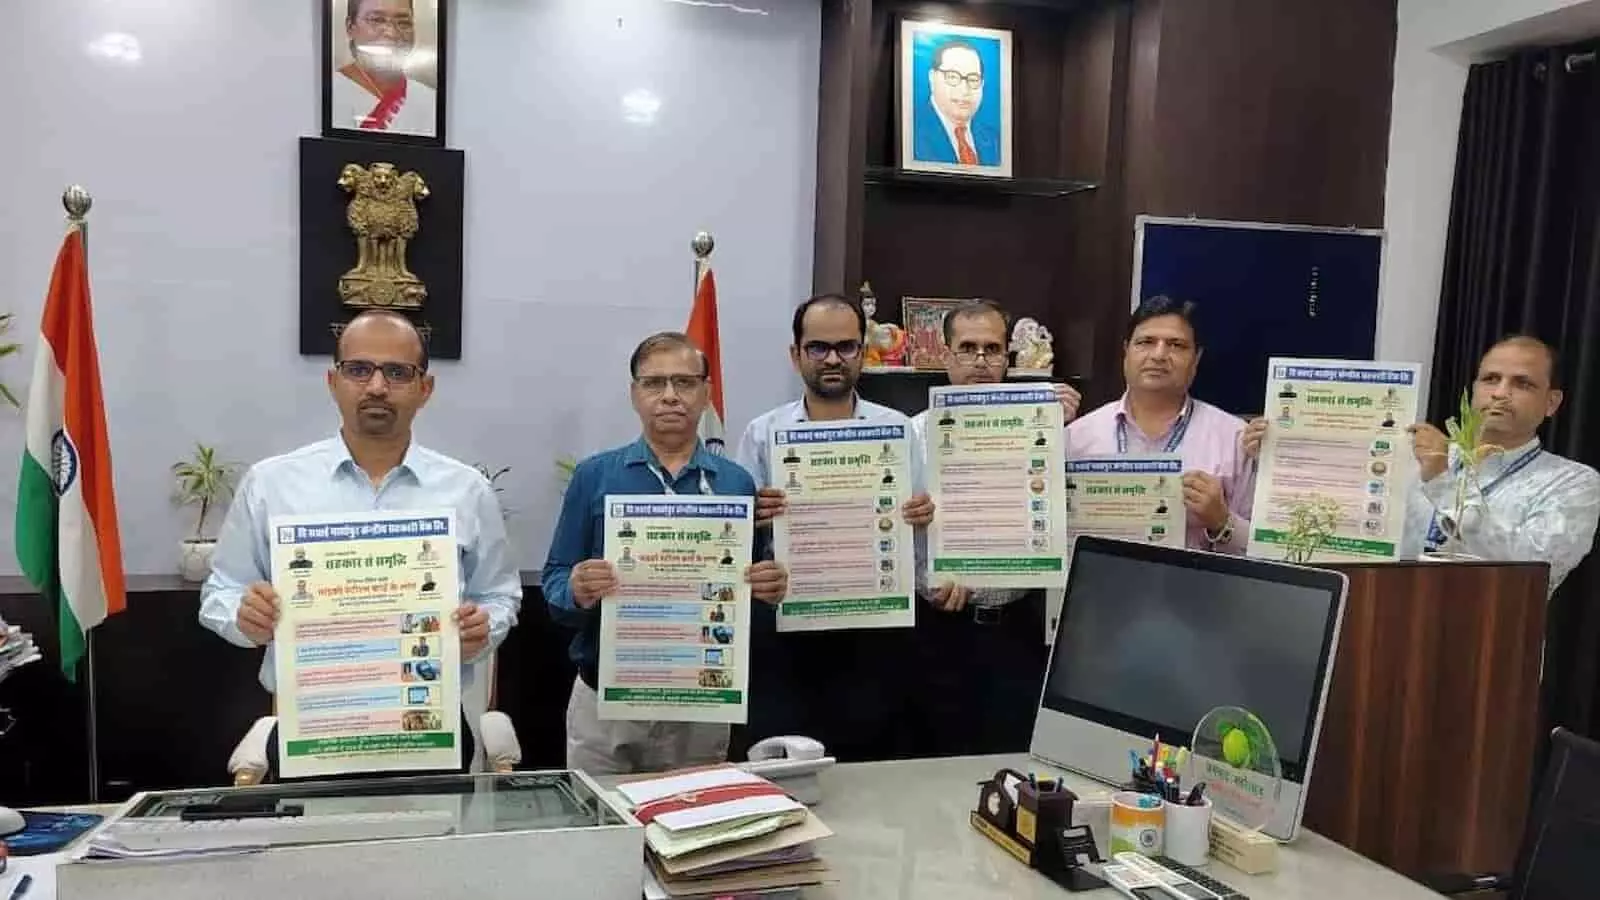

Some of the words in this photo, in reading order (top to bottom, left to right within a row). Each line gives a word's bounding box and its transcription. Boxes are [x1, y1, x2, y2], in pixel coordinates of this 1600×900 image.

[646, 531, 676, 541] सहकार
[678, 529, 685, 541] से
[686, 529, 713, 544] समृद्धि
[326, 557, 362, 570] सहकार
[365, 554, 373, 569] से
[375, 553, 407, 570] समृद्धि
